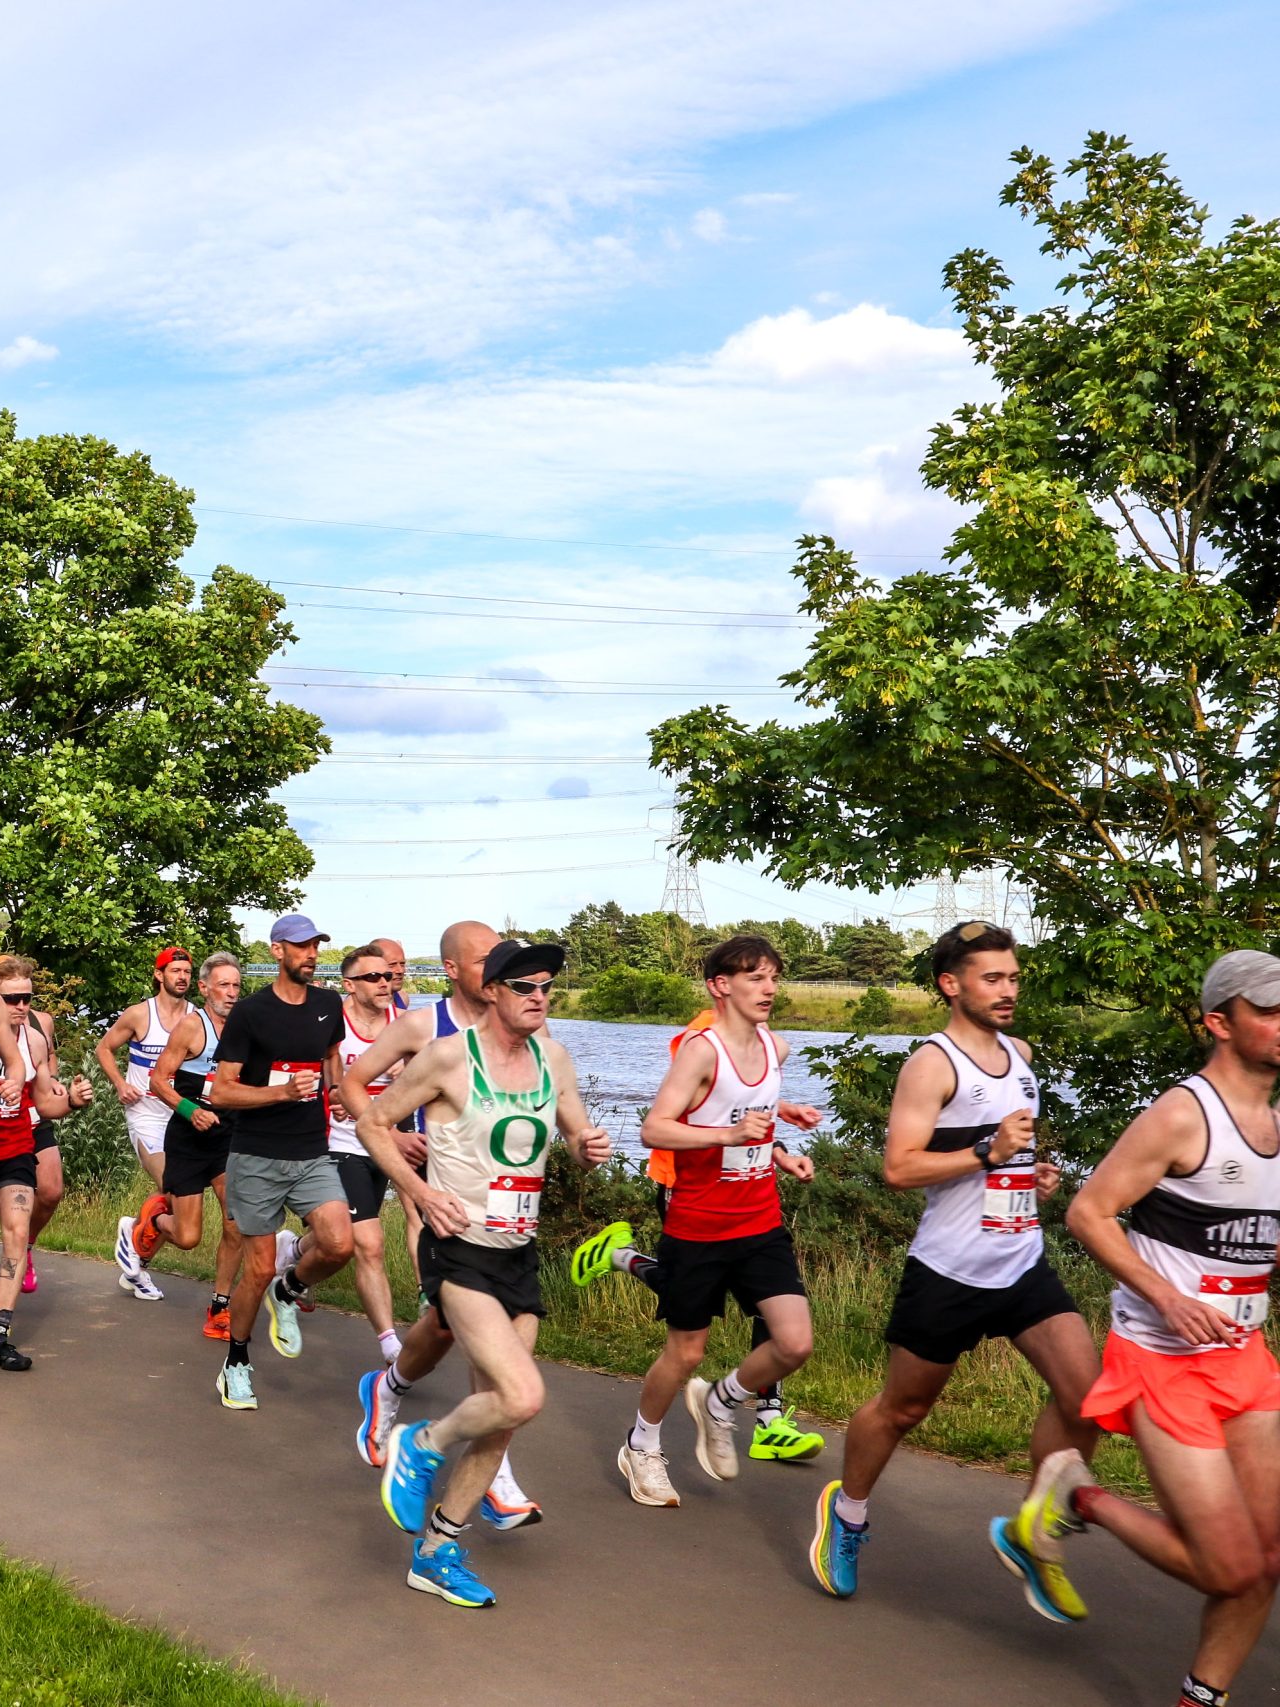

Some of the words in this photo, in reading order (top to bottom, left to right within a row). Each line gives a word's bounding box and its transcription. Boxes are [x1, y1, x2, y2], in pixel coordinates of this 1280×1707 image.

[489, 1115, 548, 1167] O
[747, 1146, 761, 1164] 97
[517, 1193, 531, 1213] 14
[1205, 1216, 1257, 1244] TYNE
[1219, 1245, 1278, 1260] HARRIER
[1235, 1296, 1254, 1321] 16
